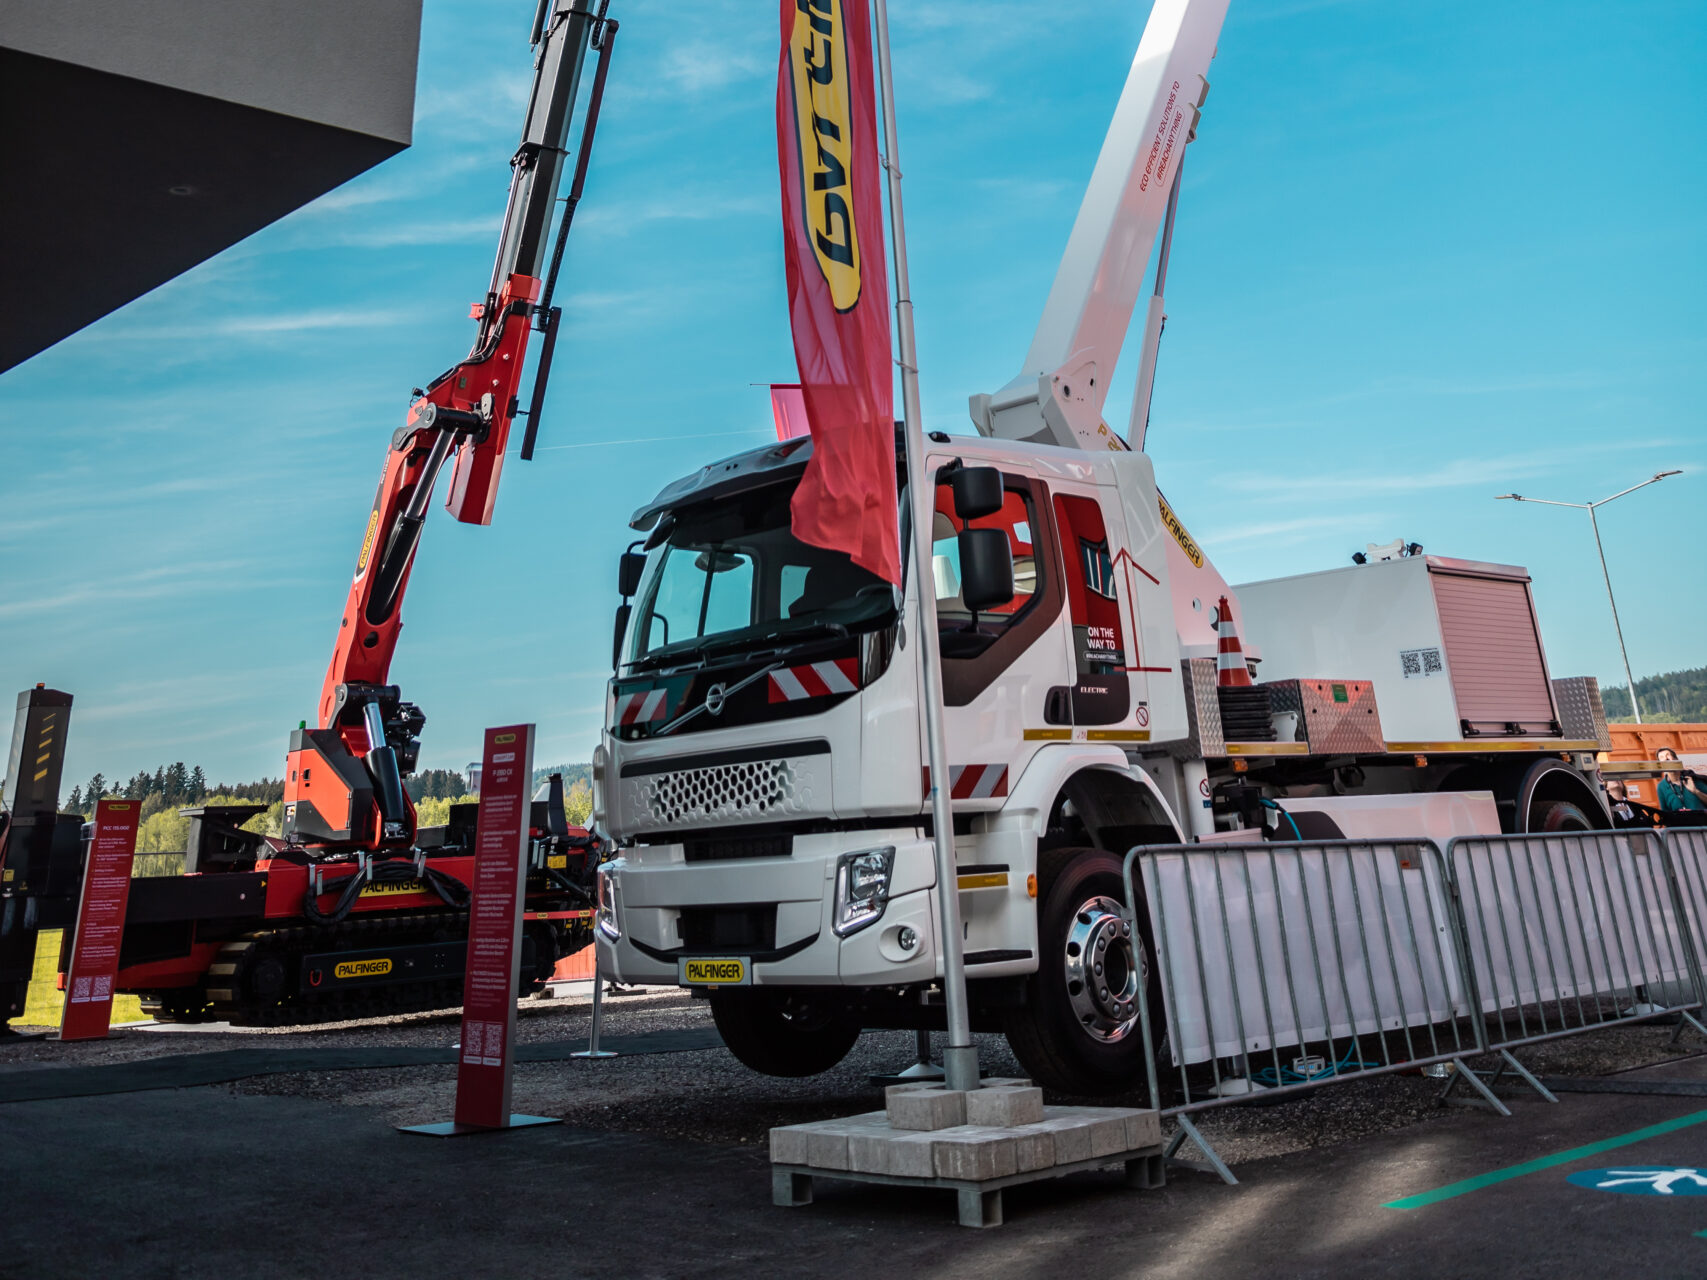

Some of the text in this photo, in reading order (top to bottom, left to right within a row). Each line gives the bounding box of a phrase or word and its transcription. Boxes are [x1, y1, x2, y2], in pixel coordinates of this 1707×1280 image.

[1140, 81, 1180, 192] ECO EFFICIENT SOLUTIONS TO
[1156, 110, 1183, 181] #REACHANYTHING
[1087, 627, 1115, 638] ON THE
[1086, 638, 1115, 650] WAY TO
[1080, 686, 1109, 695] ELECTRIC
[338, 961, 389, 976] PALFINGER
[688, 963, 740, 978] PALFINGER
